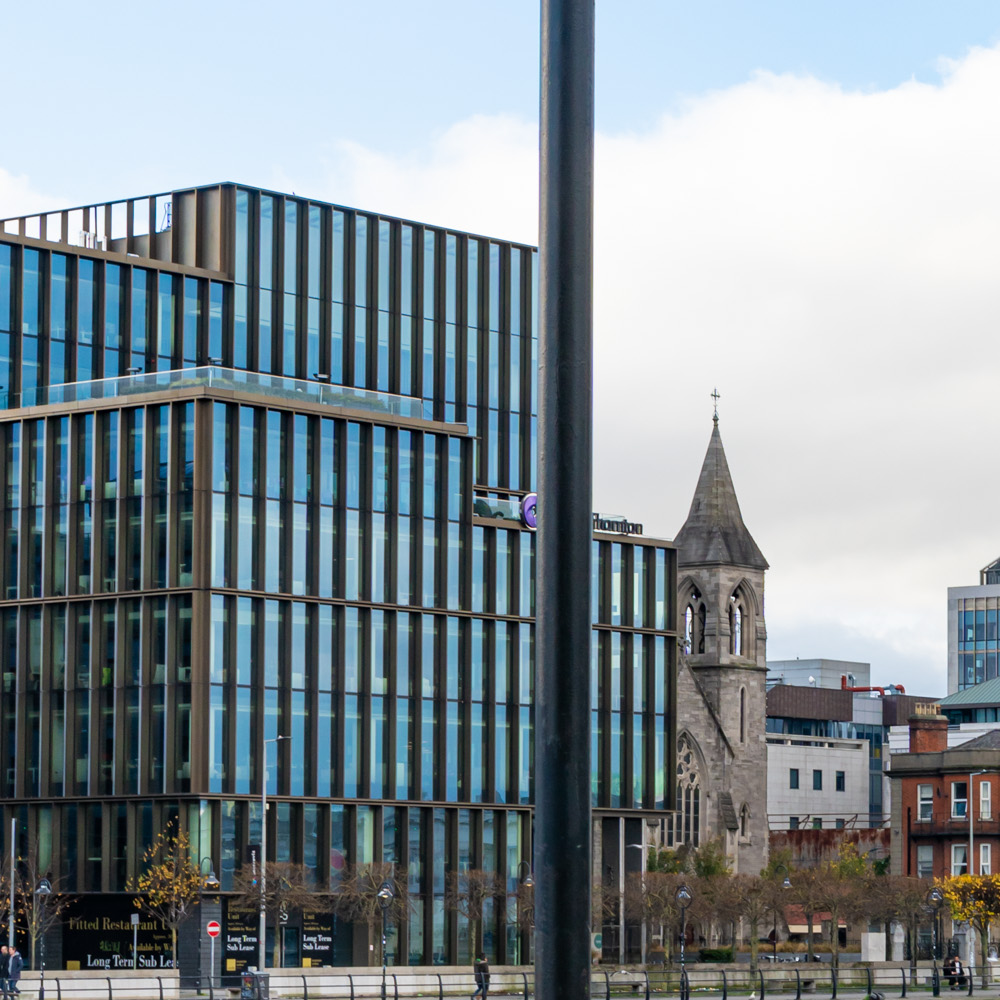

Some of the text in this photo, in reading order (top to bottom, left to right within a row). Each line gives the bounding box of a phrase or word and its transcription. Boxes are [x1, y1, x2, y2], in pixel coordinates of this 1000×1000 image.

[227, 935, 242, 944] Long
[303, 934, 317, 943] Long
[87, 954, 111, 970] Long
[138, 954, 157, 967] Sub
